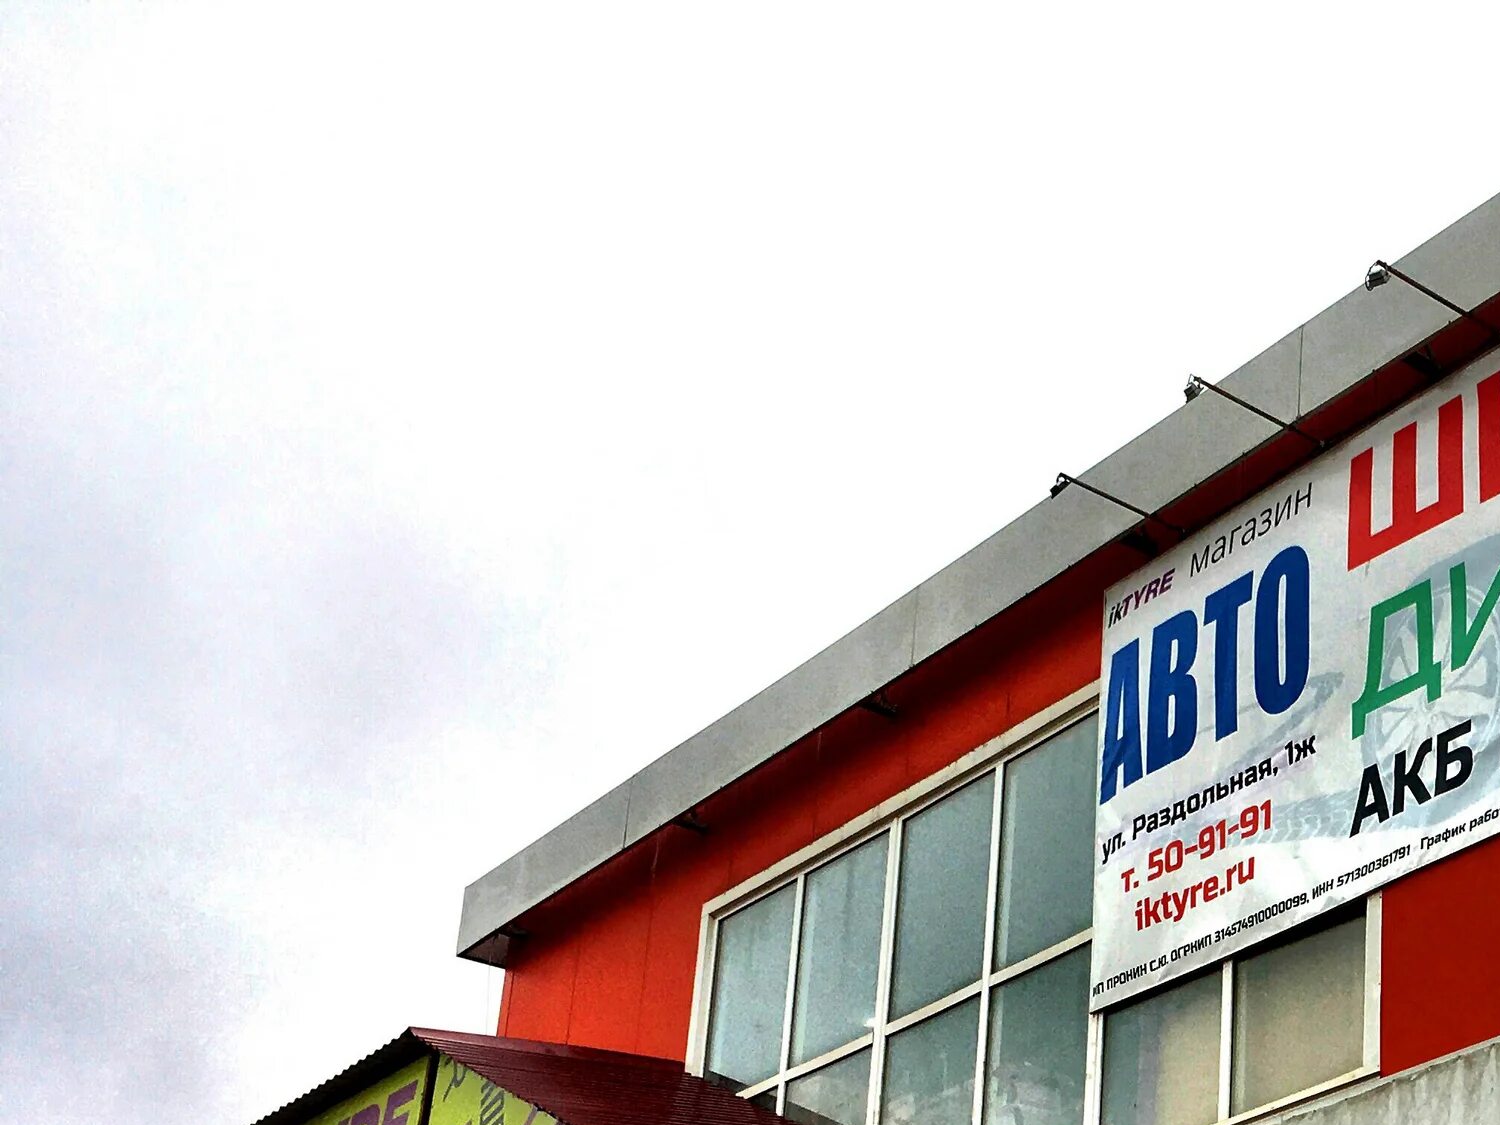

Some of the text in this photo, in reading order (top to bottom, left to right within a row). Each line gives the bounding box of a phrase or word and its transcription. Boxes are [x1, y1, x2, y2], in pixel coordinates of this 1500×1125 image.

[1108, 482, 1313, 628] ikTYRE магазин
[1100, 546, 1310, 806] АВТО
[1102, 735, 1316, 865] ул. Раздольная, 1ж
[1350, 718, 1473, 838] АКБ
[1106, 963, 1148, 991] ПРОНИН
[1149, 954, 1169, 973] С.Ю.
[1170, 934, 1212, 962] ОГРНИП
[1312, 878, 1335, 900] ИНН
[1336, 844, 1411, 887] 571300361791
[1420, 821, 1467, 851] График
[1121, 800, 1272, 893] т. 50-91-91
[1135, 857, 1255, 931] iktyre.ru
